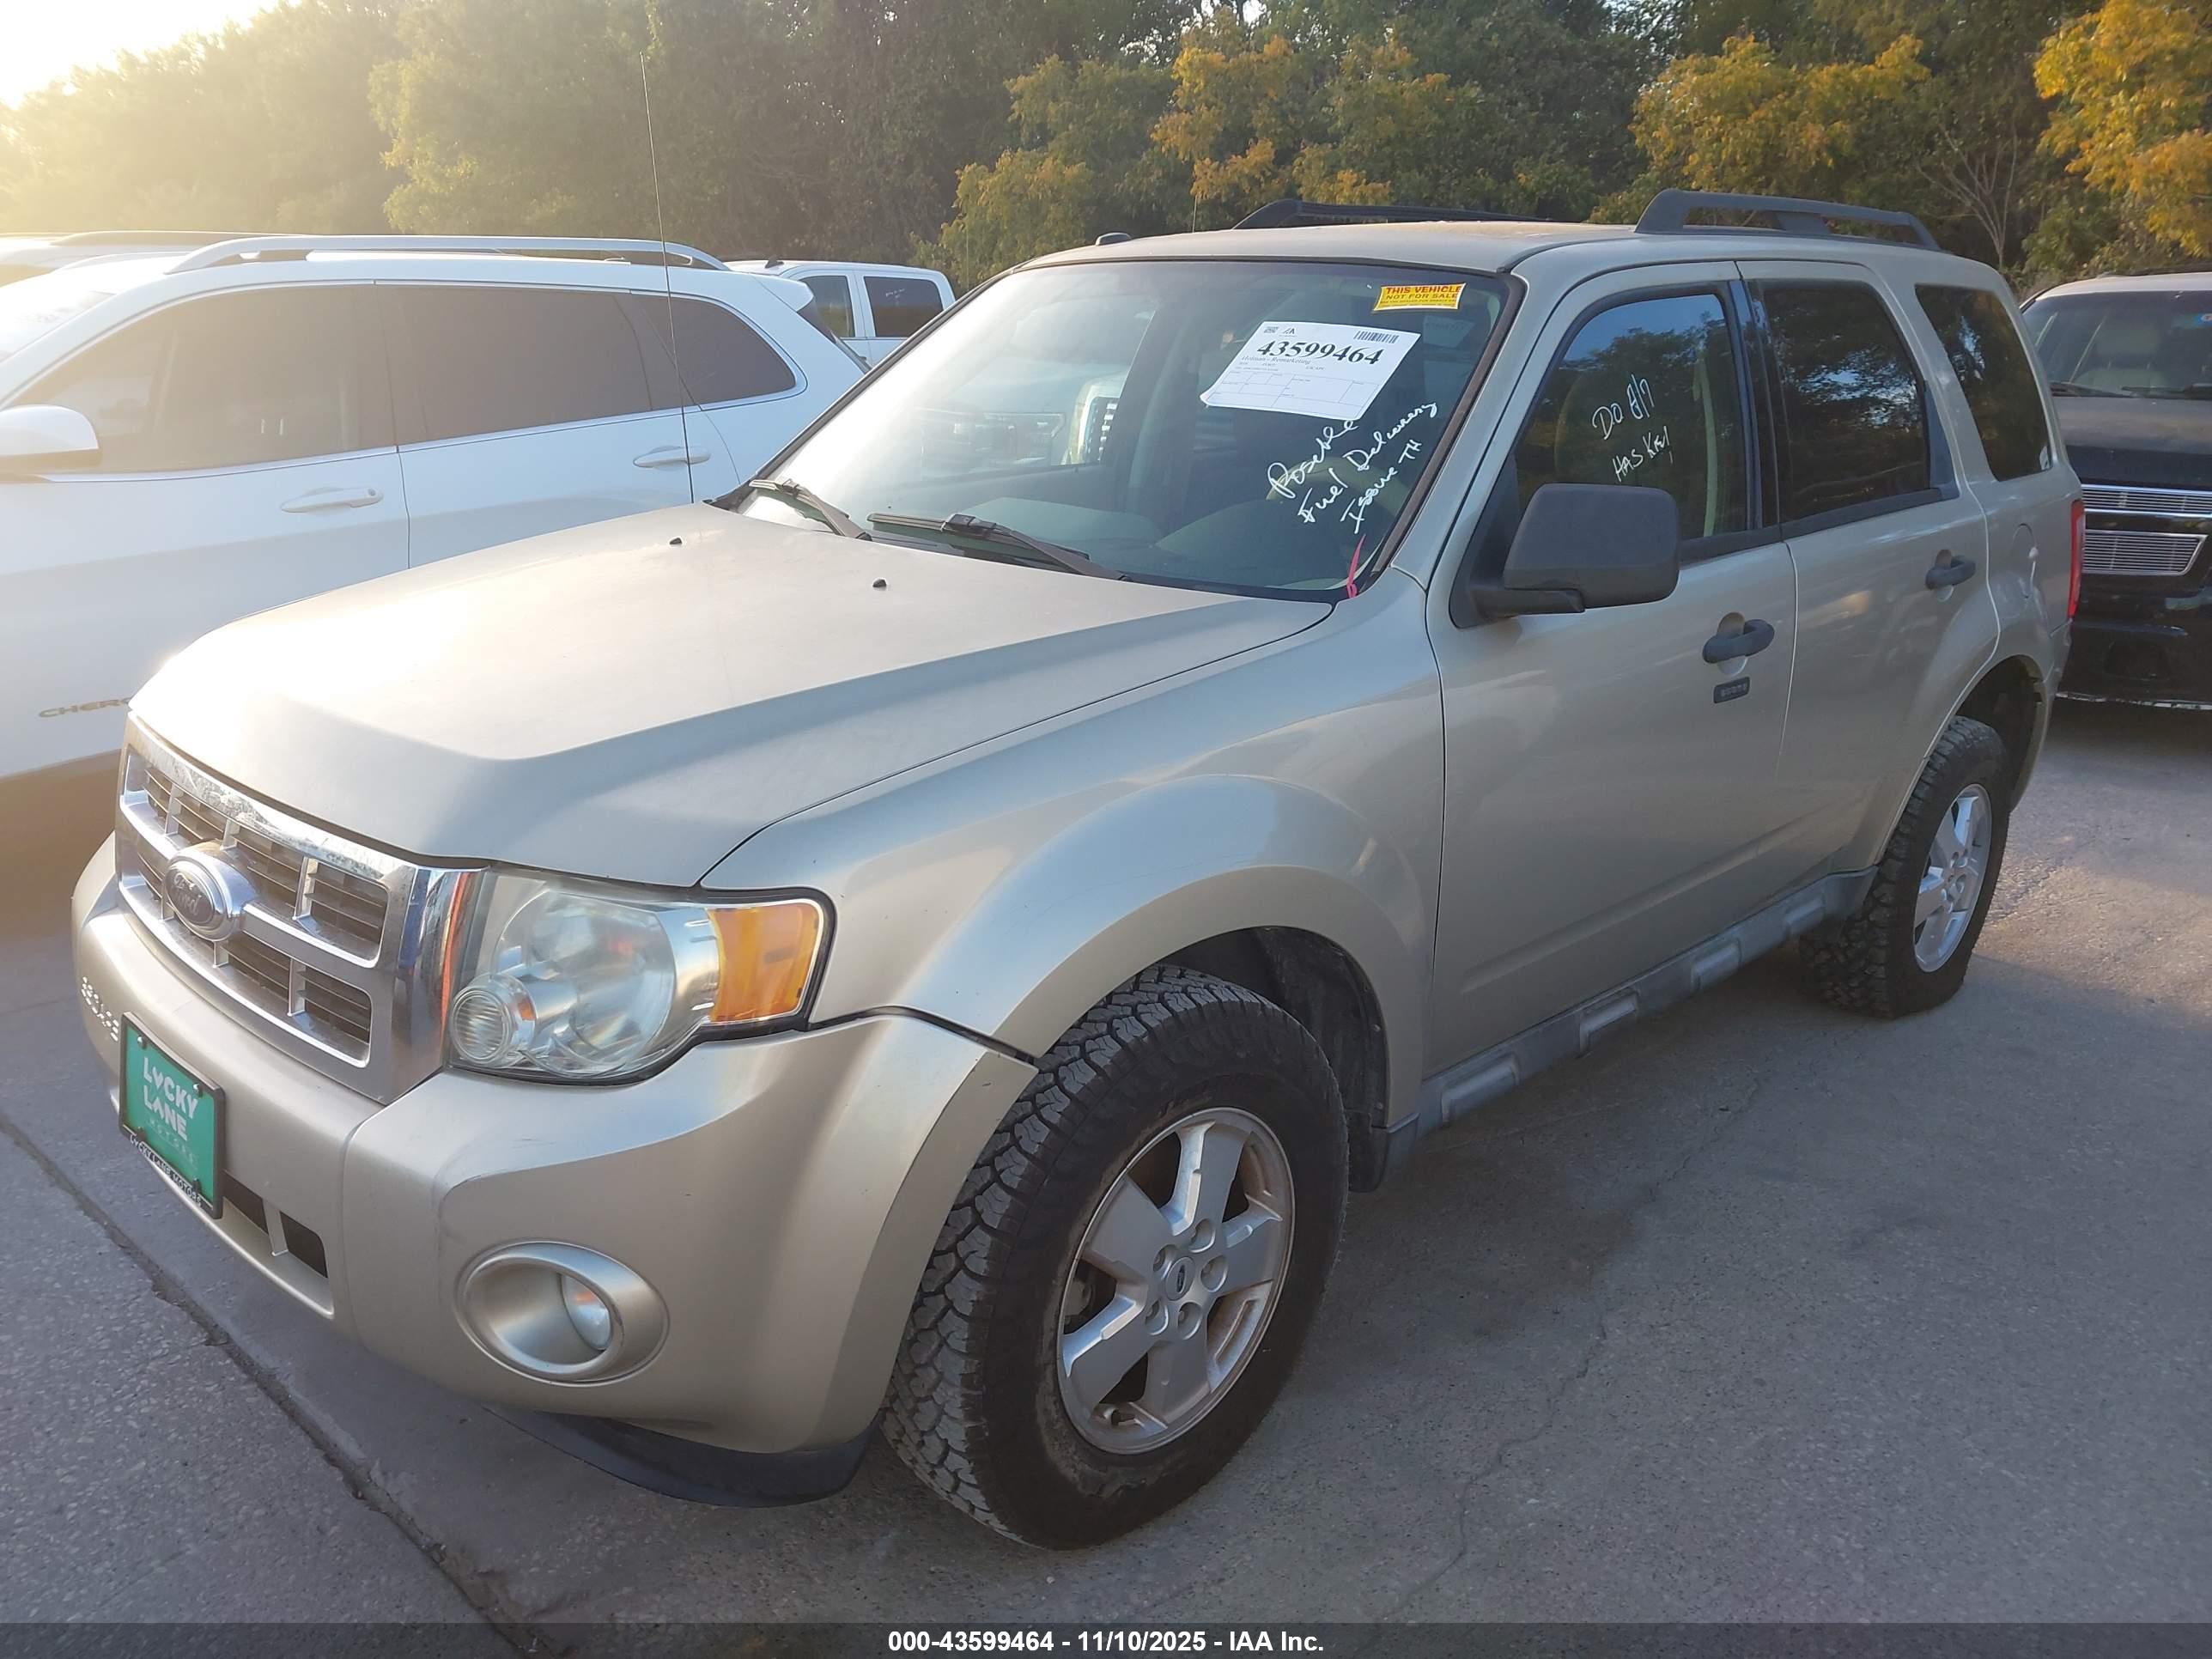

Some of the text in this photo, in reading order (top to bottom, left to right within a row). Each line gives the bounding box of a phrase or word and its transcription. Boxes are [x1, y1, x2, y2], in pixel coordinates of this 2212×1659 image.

[1256, 340, 1385, 365] 43599464
[1613, 448, 1644, 483] HAS
[1297, 467, 1348, 523] Fuel
[143, 1056, 198, 1120] LUCKY
[143, 1085, 188, 1141] LANE
